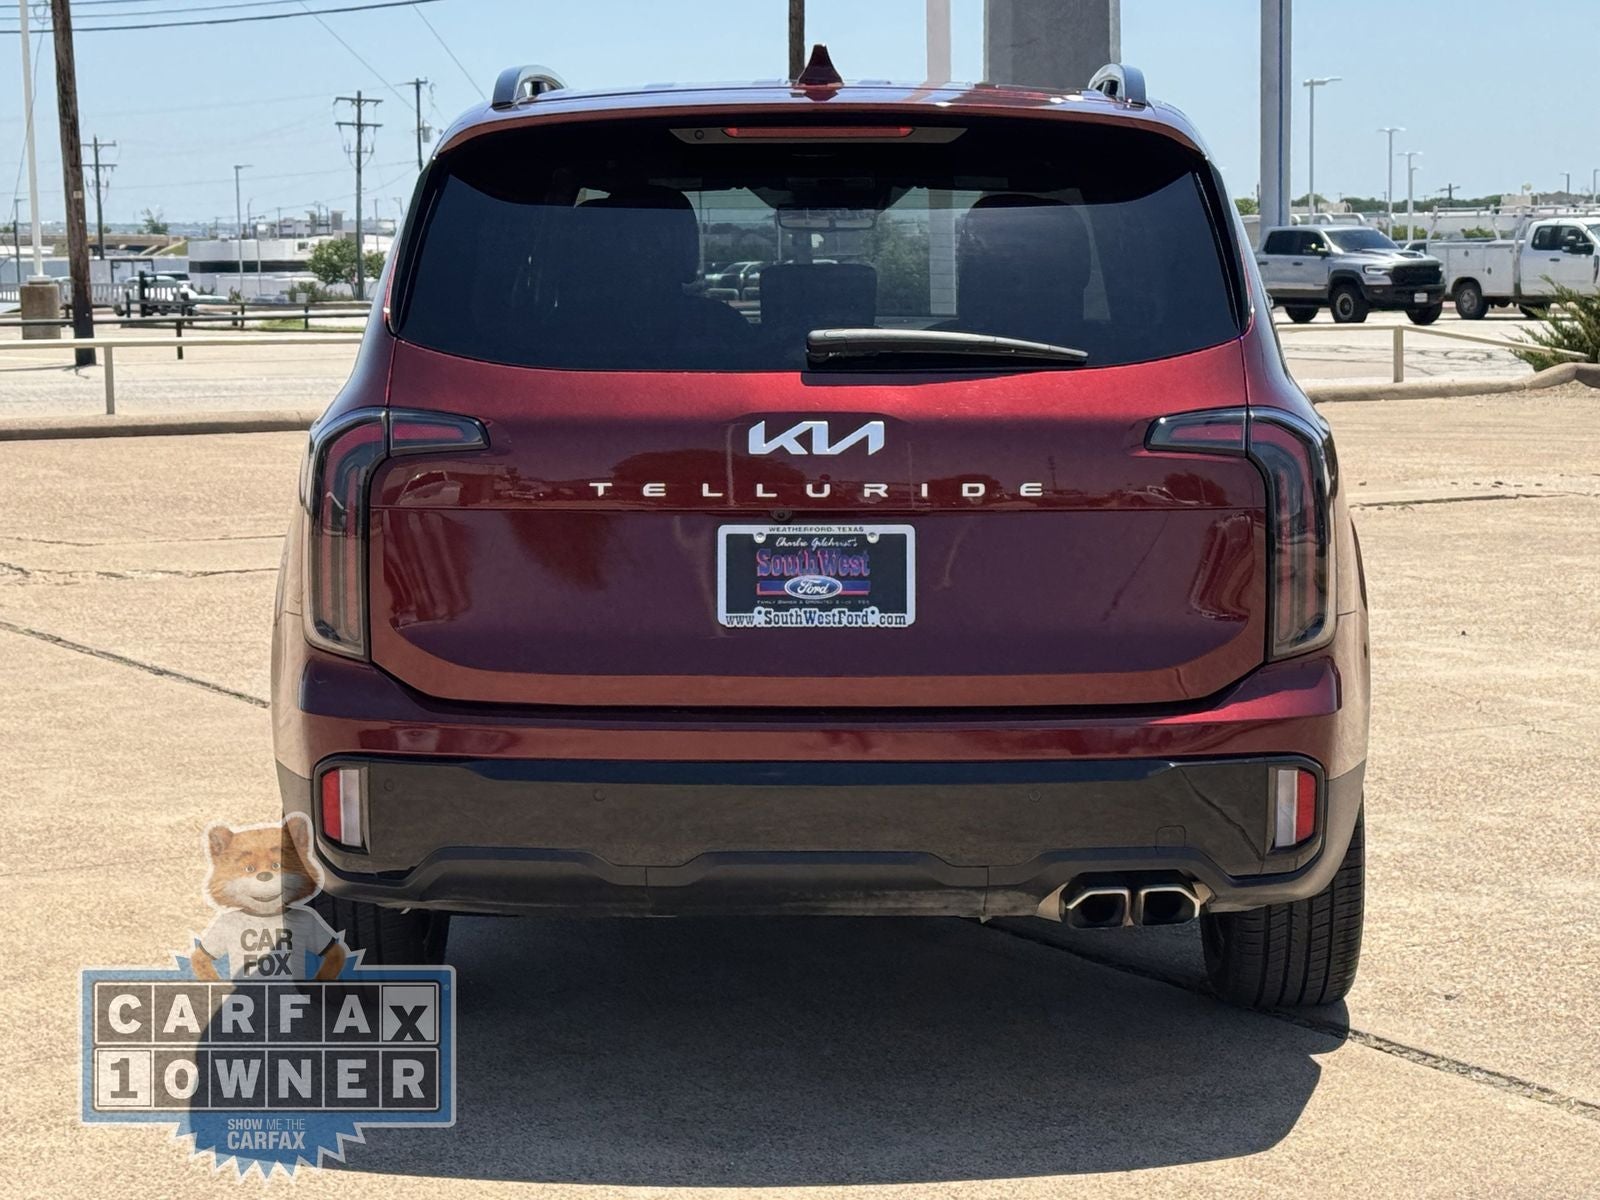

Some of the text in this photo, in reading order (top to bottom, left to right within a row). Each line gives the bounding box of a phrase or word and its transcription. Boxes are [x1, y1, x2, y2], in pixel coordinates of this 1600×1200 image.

[588, 482, 1043, 498] TELLURIDE
[775, 537, 809, 547] Charlie
[756, 549, 871, 577] SouthWest
[797, 579, 829, 595] Ford
[725, 609, 907, 626] www.SouthWestFord.com
